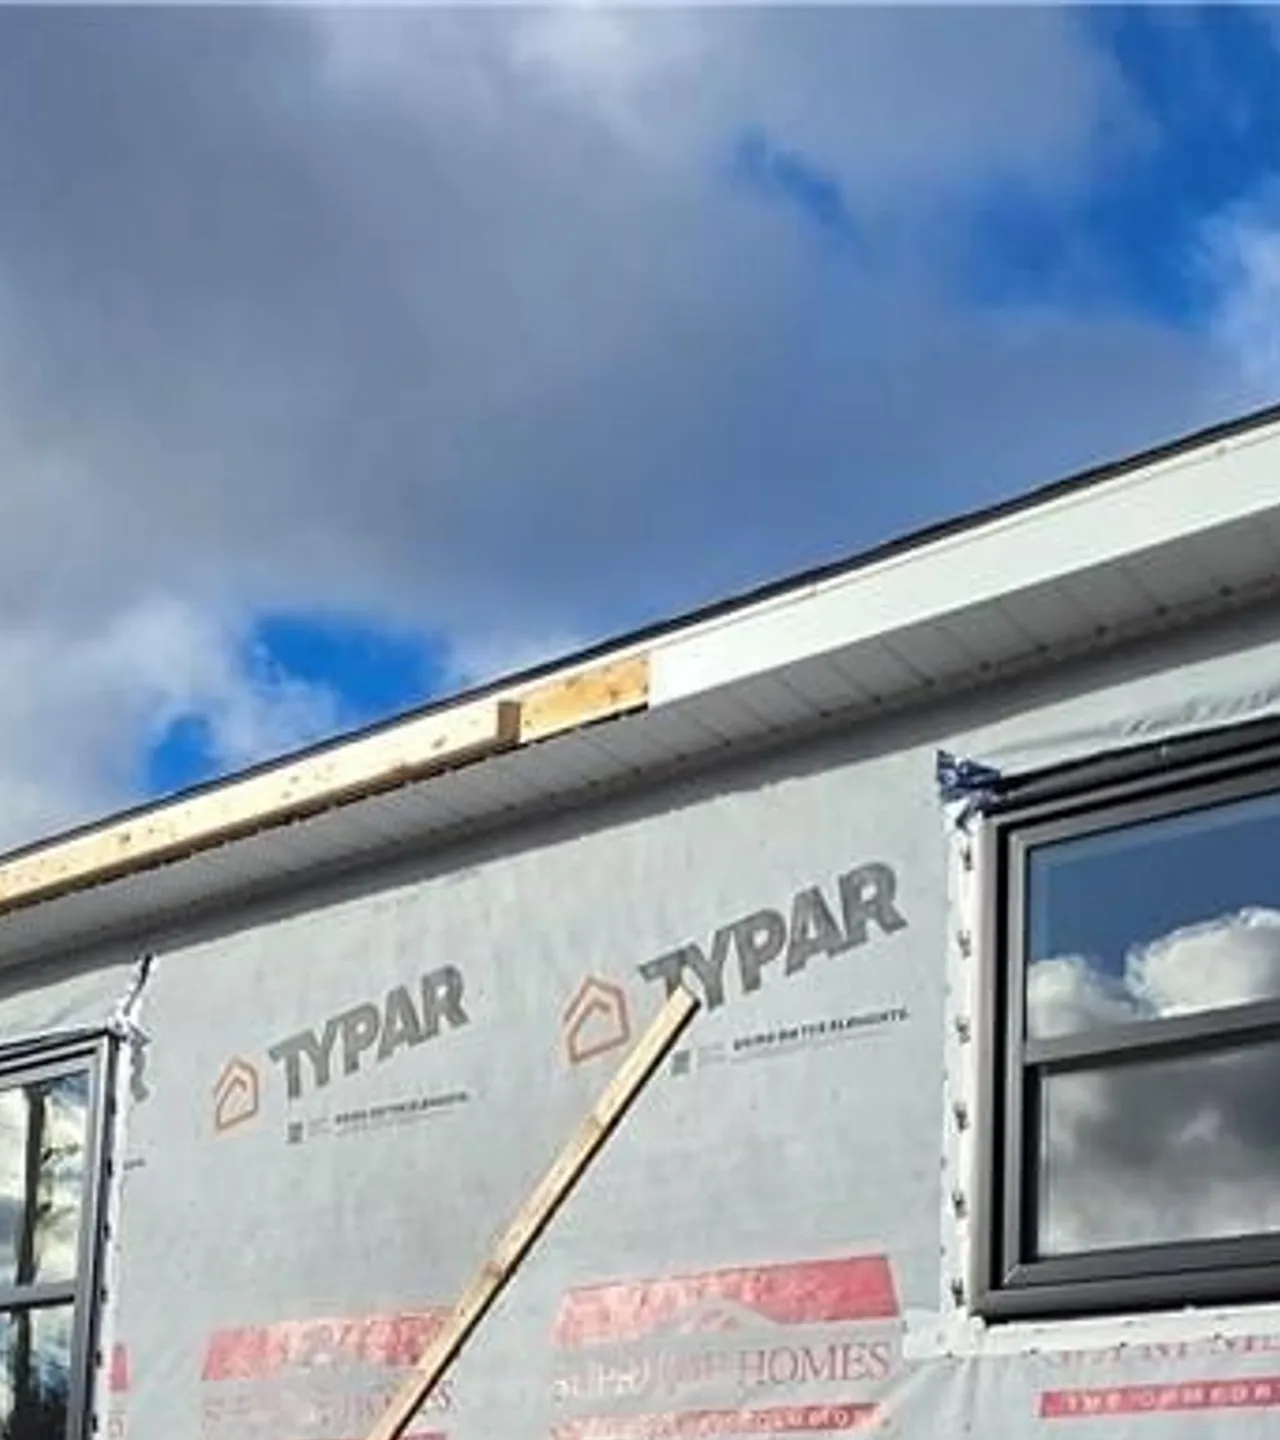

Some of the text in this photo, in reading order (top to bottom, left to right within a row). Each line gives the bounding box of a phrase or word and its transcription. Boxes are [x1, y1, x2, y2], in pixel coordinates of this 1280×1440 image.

[639, 862, 908, 1012] TYPAR
[269, 974, 471, 1099] TYPAR
[742, 1341, 891, 1387] HOMES
